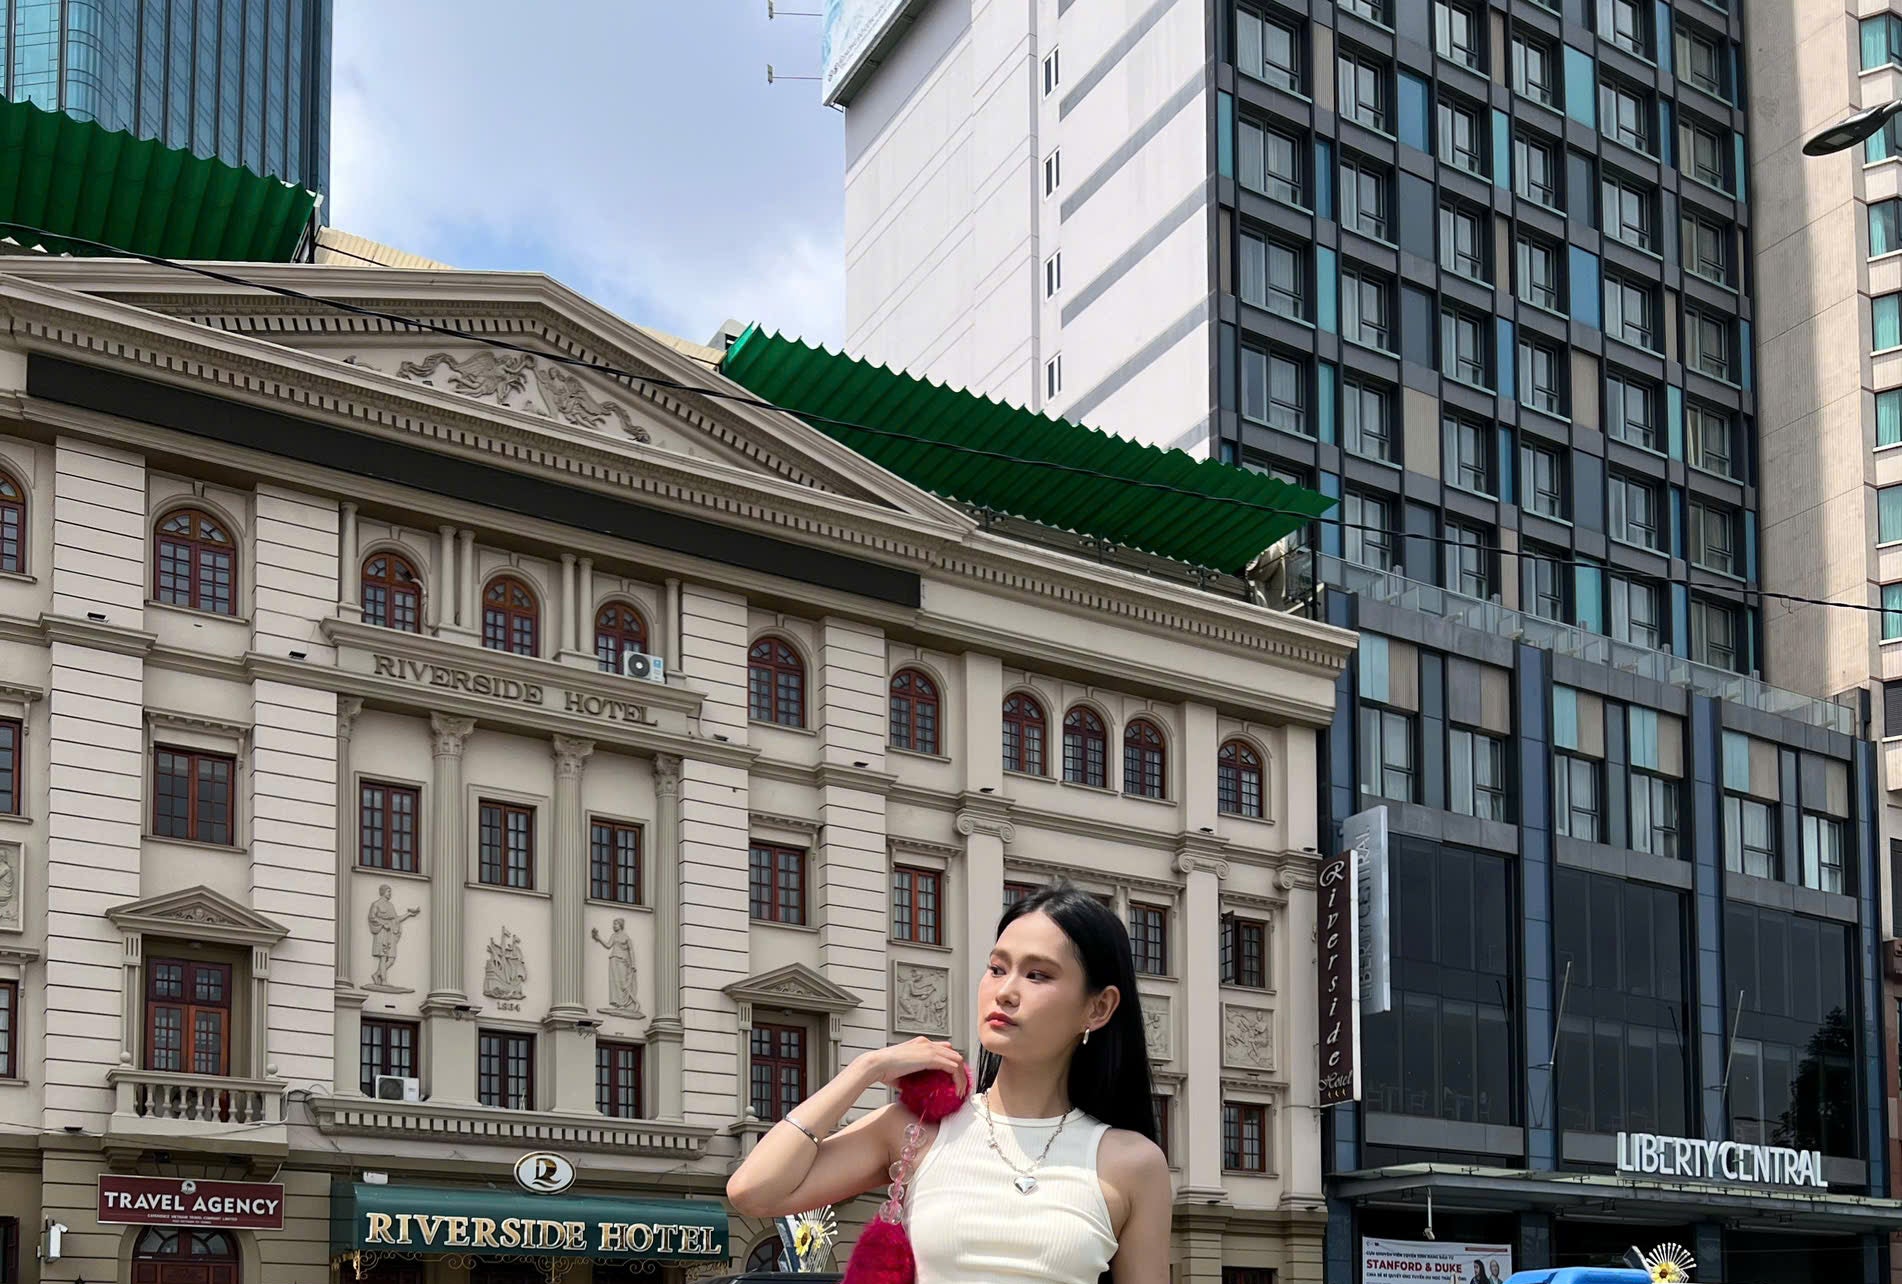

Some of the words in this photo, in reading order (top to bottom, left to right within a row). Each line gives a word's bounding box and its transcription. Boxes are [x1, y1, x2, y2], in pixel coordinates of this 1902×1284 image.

[373, 654, 544, 705] RIVERSIDE
[564, 691, 658, 728] HOTEL
[1319, 859, 1345, 1067] Riverside
[1318, 1070, 1353, 1092] Hotel
[1616, 1132, 1719, 1178] LIBERTY
[1718, 1140, 1828, 1187] CENTRAL
[104, 1191, 185, 1211] TRAVEL
[192, 1196, 279, 1215] AGENCY
[366, 1212, 587, 1251] RIVERSIDE
[598, 1222, 722, 1255] HOTEL
[1366, 1259, 1422, 1272] STANFORD
[1425, 1262, 1432, 1272] &
[1435, 1263, 1462, 1273] DUKE
